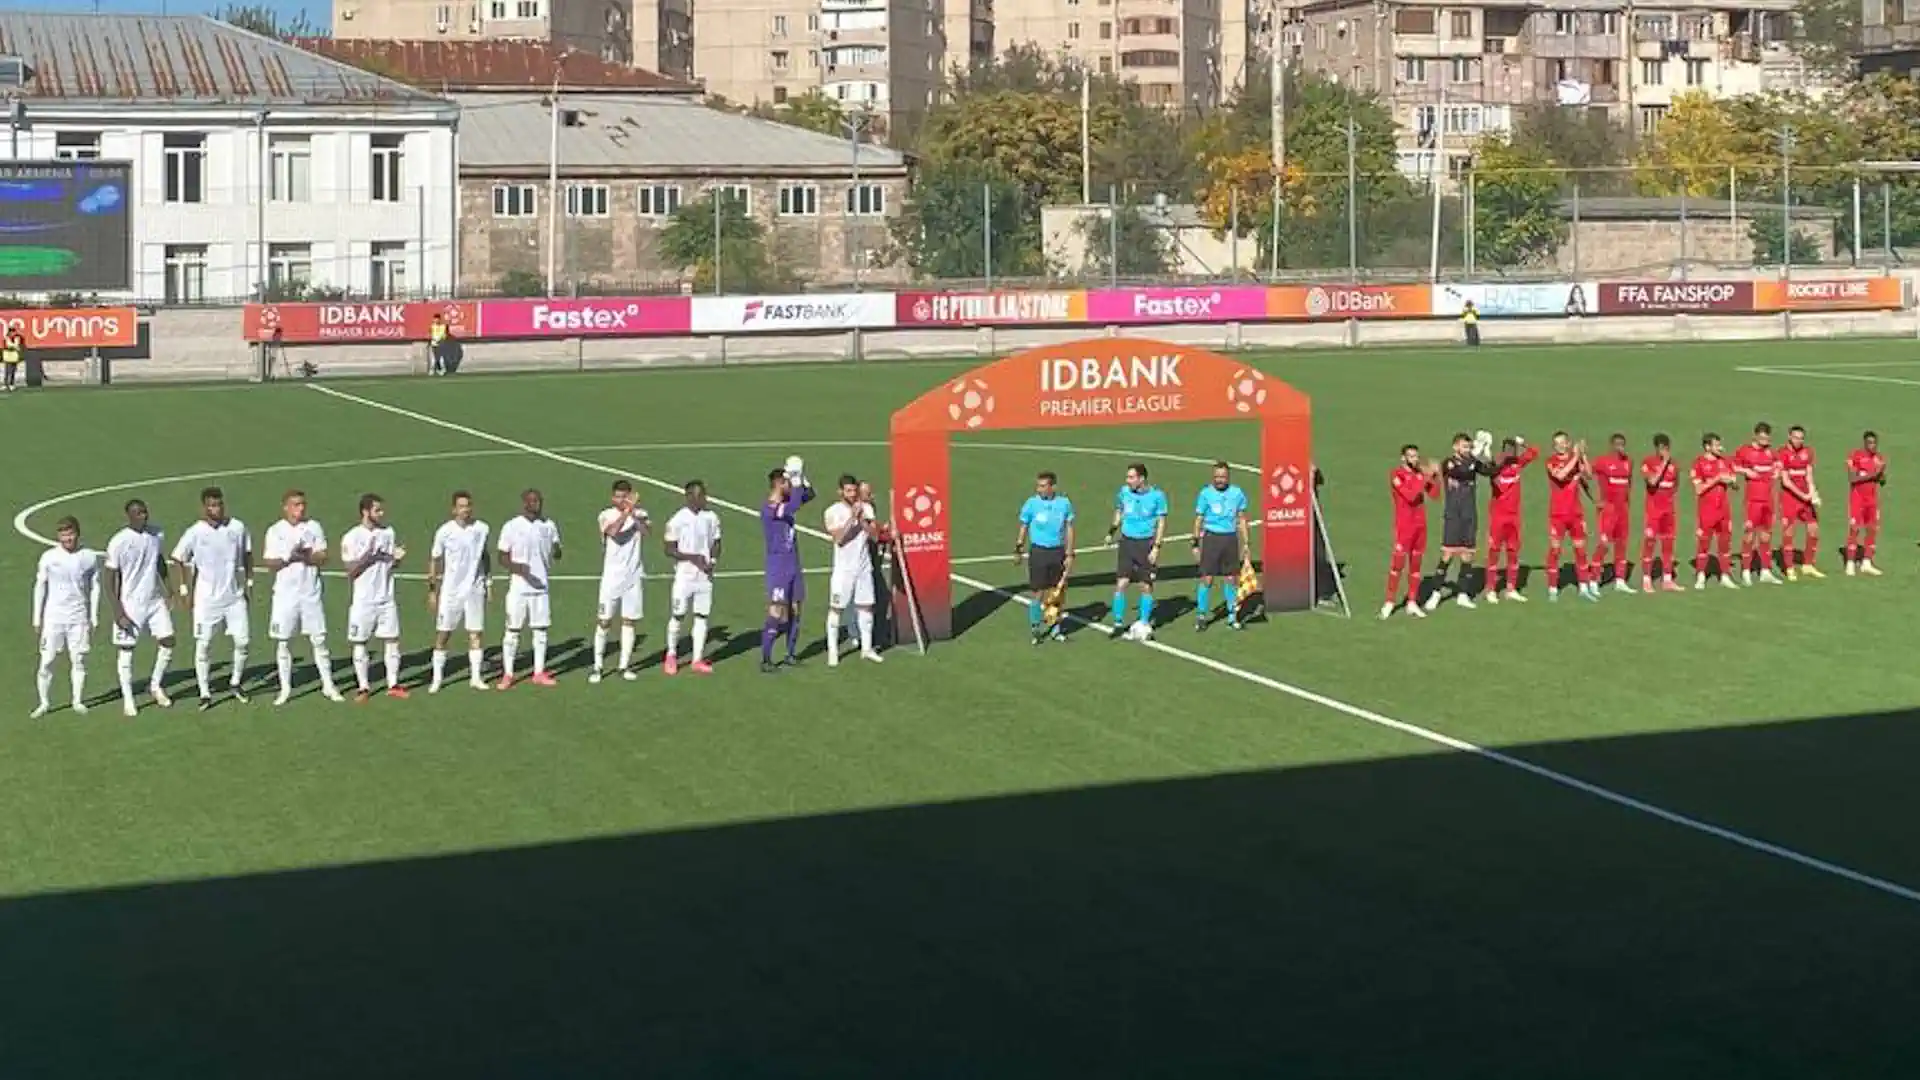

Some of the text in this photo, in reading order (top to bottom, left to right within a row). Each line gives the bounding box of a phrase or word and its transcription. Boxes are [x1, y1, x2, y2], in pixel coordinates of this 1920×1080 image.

[1330, 290, 1397, 311] IDBank
[1618, 283, 1736, 303] FFA FANSHOP
[319, 304, 406, 325] IDBANK
[763, 303, 849, 321] FASTBANK
[1133, 293, 1212, 316] Fastex
[531, 304, 629, 330] Fastex
[1040, 353, 1186, 392] IDBANK
[1040, 394, 1184, 417] PREMIER LEAGUE
